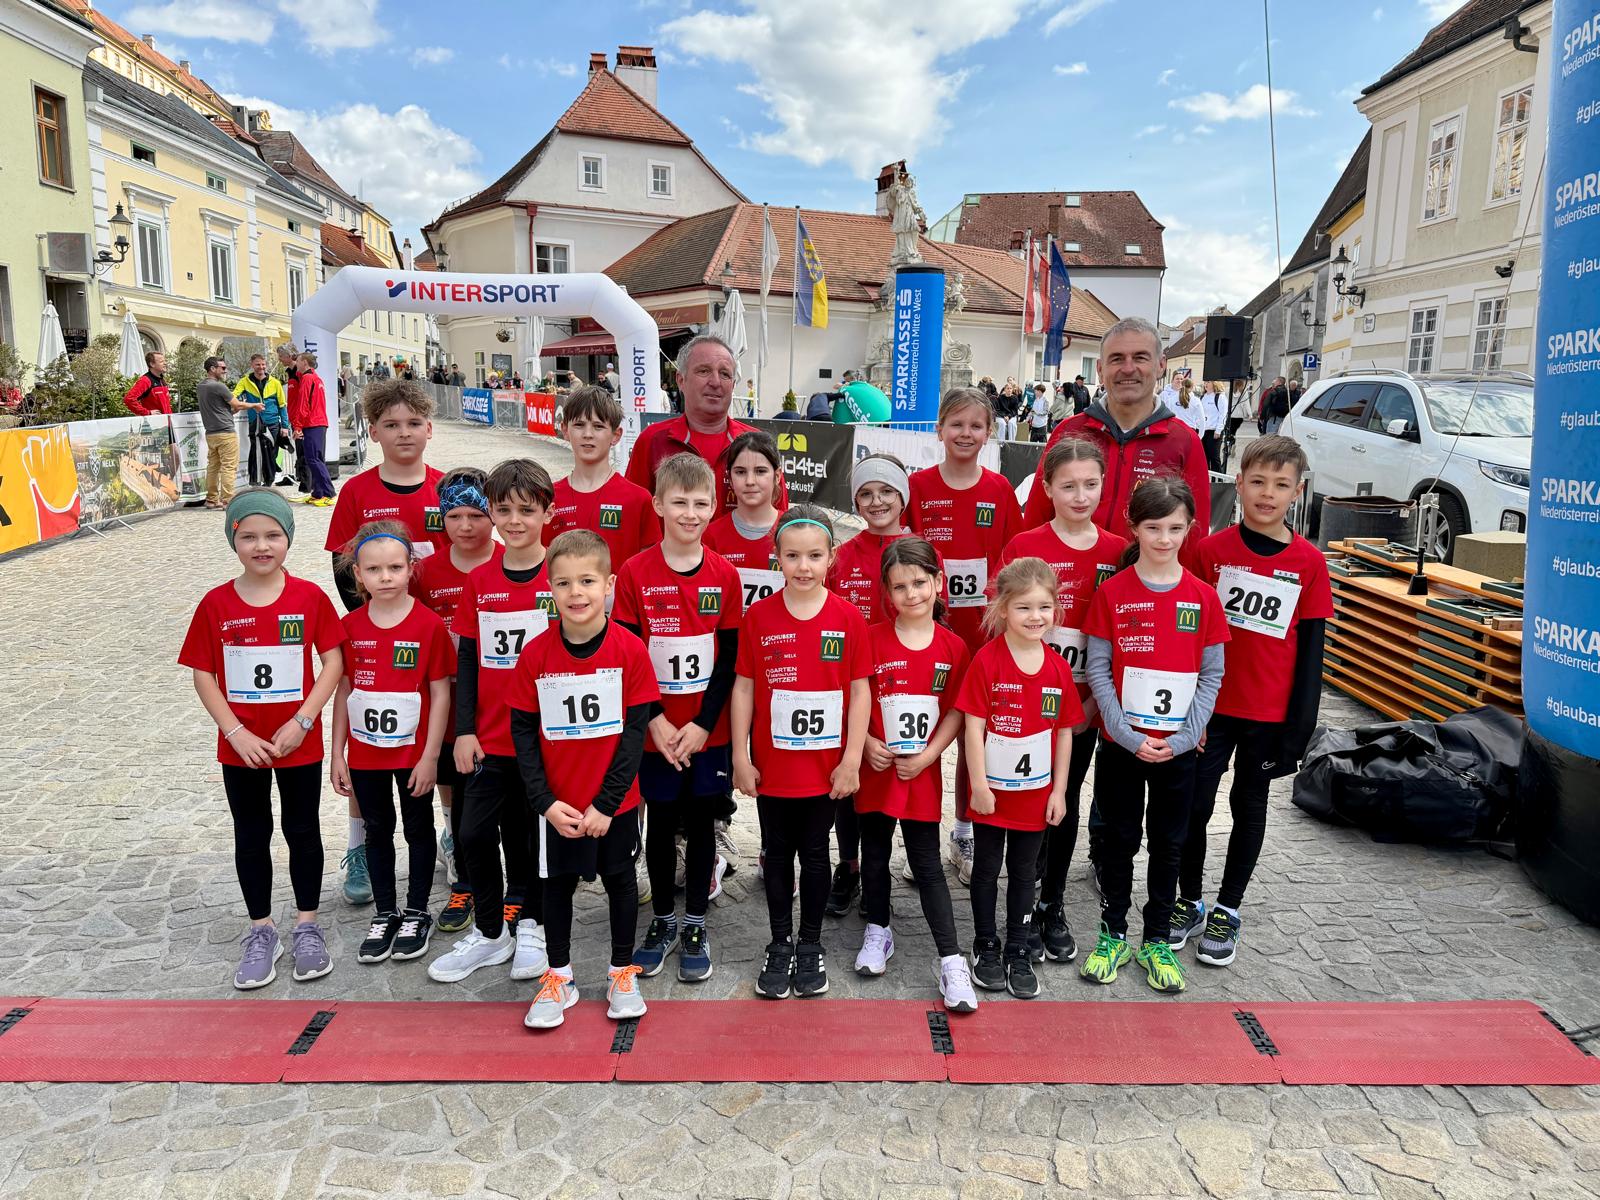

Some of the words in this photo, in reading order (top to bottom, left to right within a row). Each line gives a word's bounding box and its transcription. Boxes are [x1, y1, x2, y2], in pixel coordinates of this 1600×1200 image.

[411, 281, 560, 303] INTERSPORT
[913, 289, 922, 312] West
[912, 314, 921, 338] Mitte
[896, 308, 912, 411] SPARKASSE
[1306, 355, 1315, 367] P
[908, 339, 919, 411] Niederösterreich
[1540, 504, 1600, 523] Niederösterrei
[437, 586, 464, 594] SCHUBERT
[949, 574, 977, 596] 63
[1224, 586, 1282, 621] 208
[226, 617, 256, 626] SCHUBERT
[494, 629, 527, 655] 37
[768, 633, 797, 641] SCHUBERT
[254, 664, 273, 689] 8
[668, 654, 700, 680] 13
[880, 660, 908, 669] SCHUBERT
[562, 694, 601, 724] 16
[1153, 689, 1173, 715] 3
[364, 708, 398, 734] 66
[791, 709, 825, 736] 65
[899, 712, 929, 739] 36
[1014, 753, 1032, 777] 4
[1175, 903, 1187, 911] FILA
